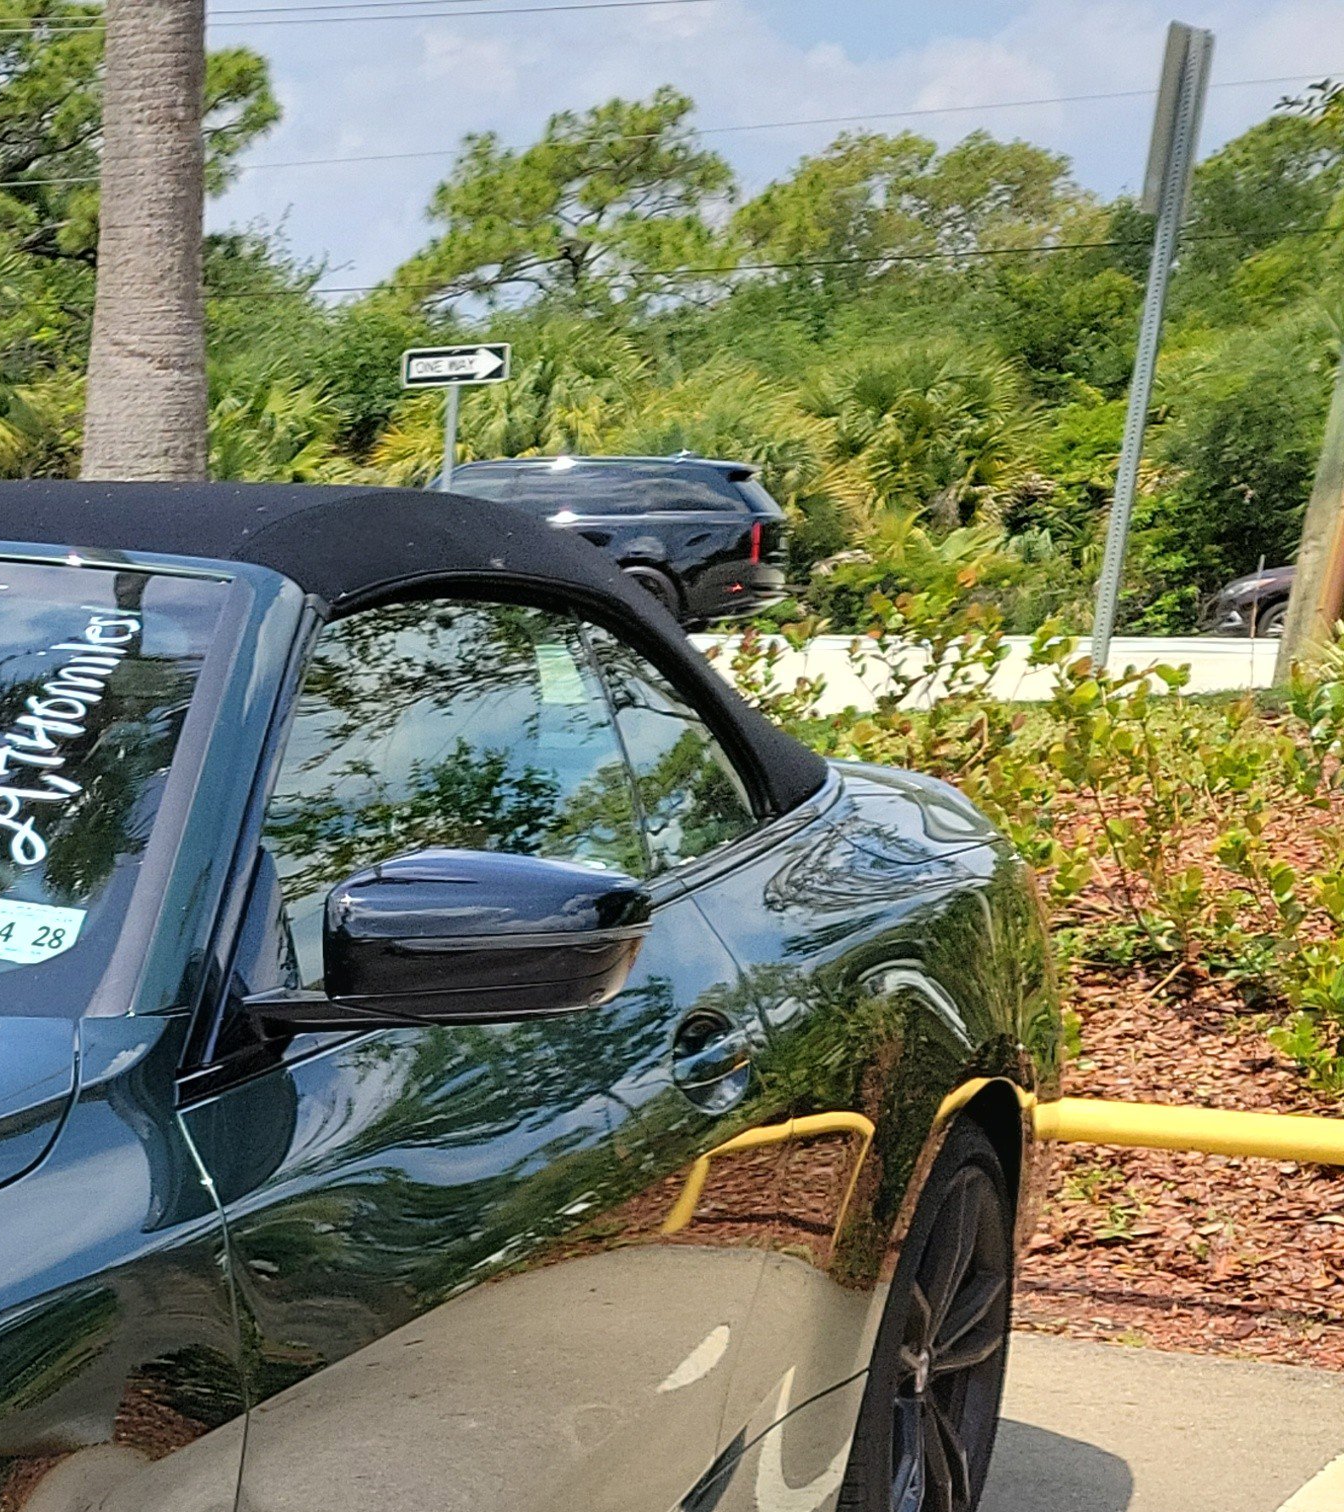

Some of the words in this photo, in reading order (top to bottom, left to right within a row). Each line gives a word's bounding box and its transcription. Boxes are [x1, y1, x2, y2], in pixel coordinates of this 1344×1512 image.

[415, 360, 445, 374] ONE
[448, 358, 476, 372] WAY
[30, 925, 66, 950] 28
